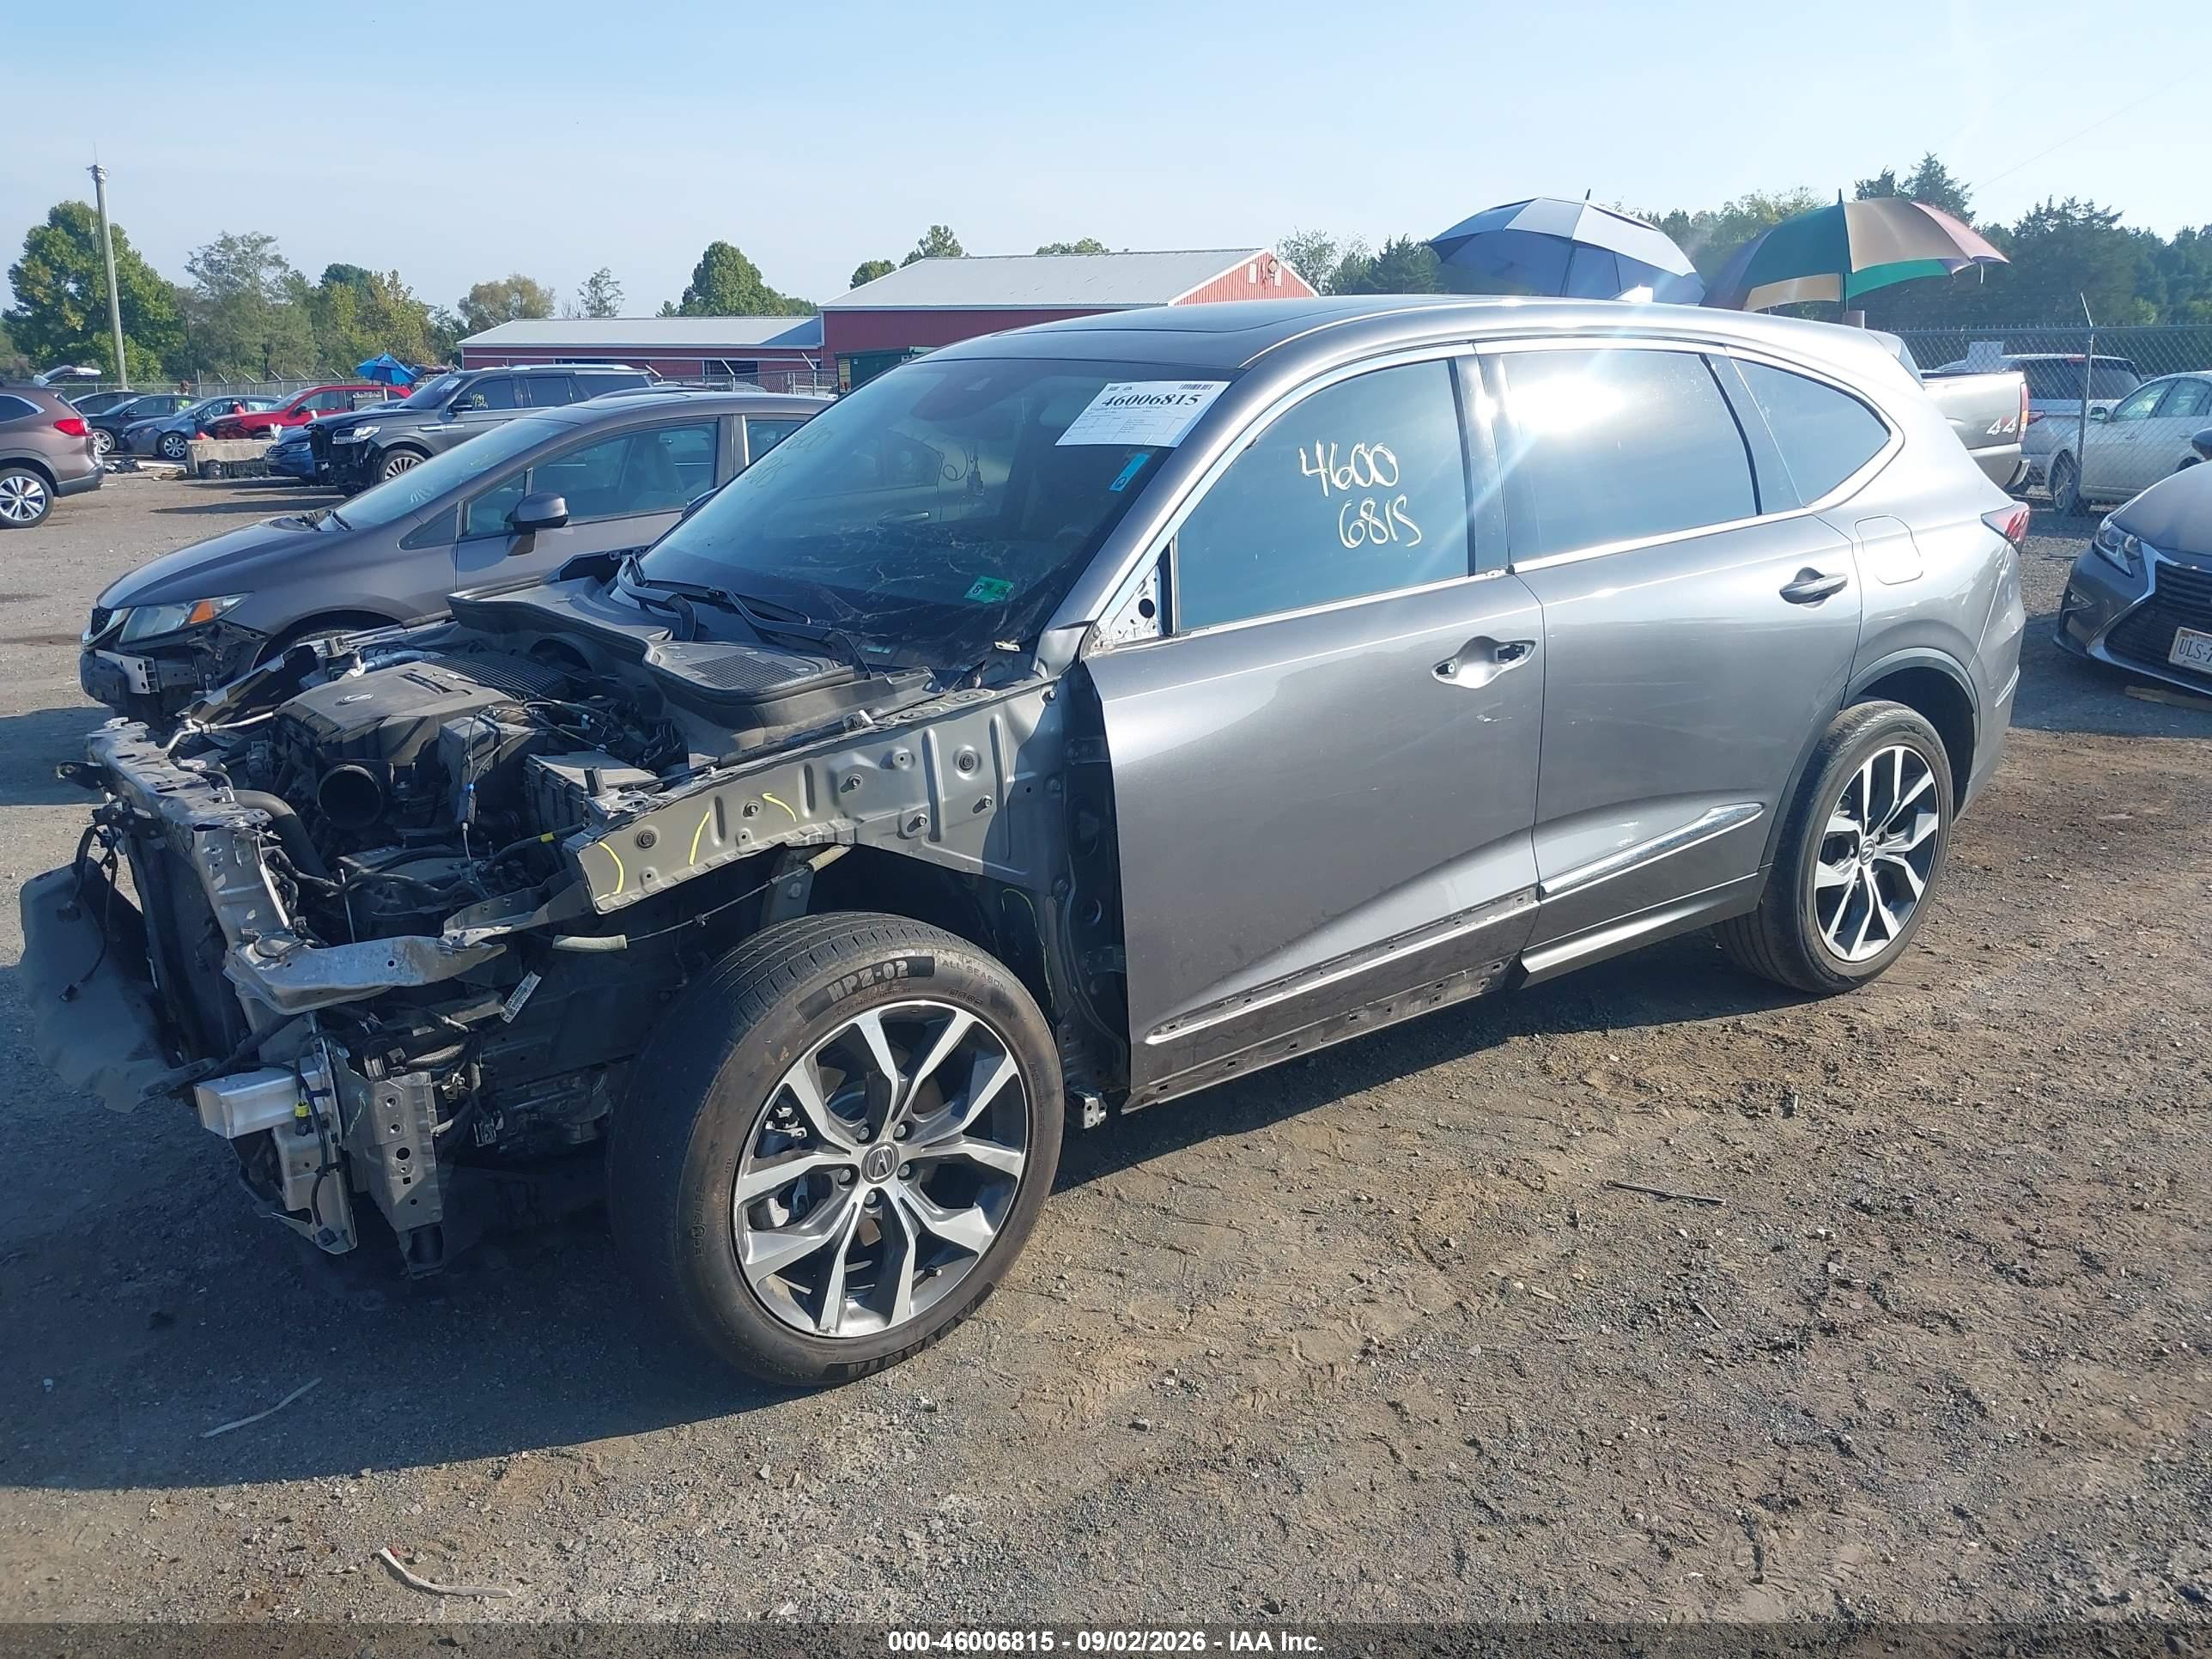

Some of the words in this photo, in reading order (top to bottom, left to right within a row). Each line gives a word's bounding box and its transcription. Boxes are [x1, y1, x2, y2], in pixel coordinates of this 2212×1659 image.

[1101, 393, 1203, 406] 46006815
[1298, 439, 1400, 497] 4600
[1338, 493, 1423, 549] 6815
[942, 960, 963, 970] ALL
